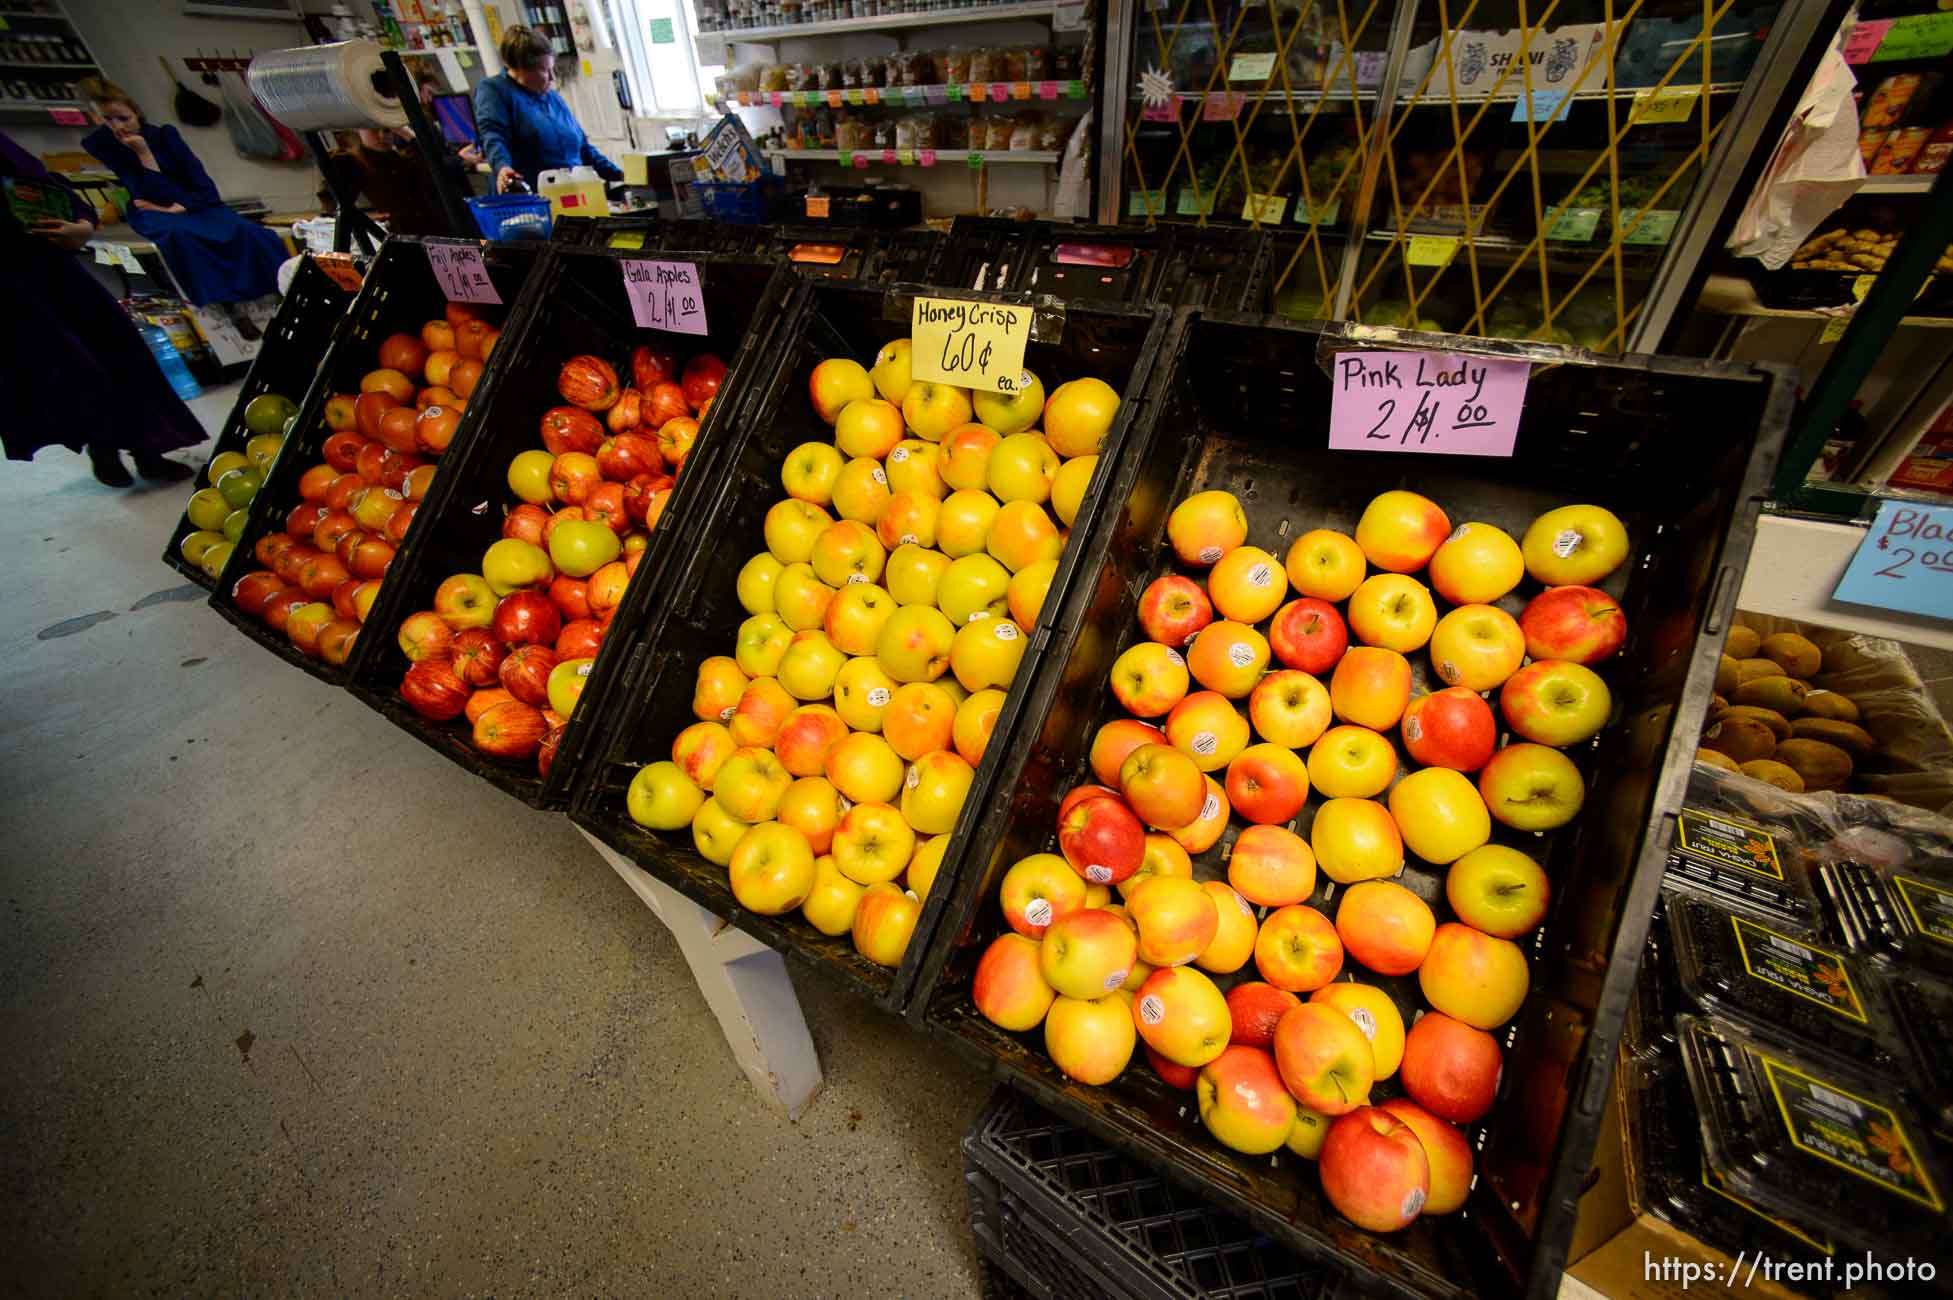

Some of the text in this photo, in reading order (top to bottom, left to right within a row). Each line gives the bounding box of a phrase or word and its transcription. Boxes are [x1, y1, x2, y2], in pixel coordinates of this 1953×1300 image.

[449, 249, 477, 267] Apples
[625, 262, 690, 287] Gala Apples
[918, 301, 1018, 335] Honey Crisp
[941, 332, 992, 375] 60¢
[997, 375, 1019, 391] ea.
[1338, 357, 1488, 403] Pink Lady
